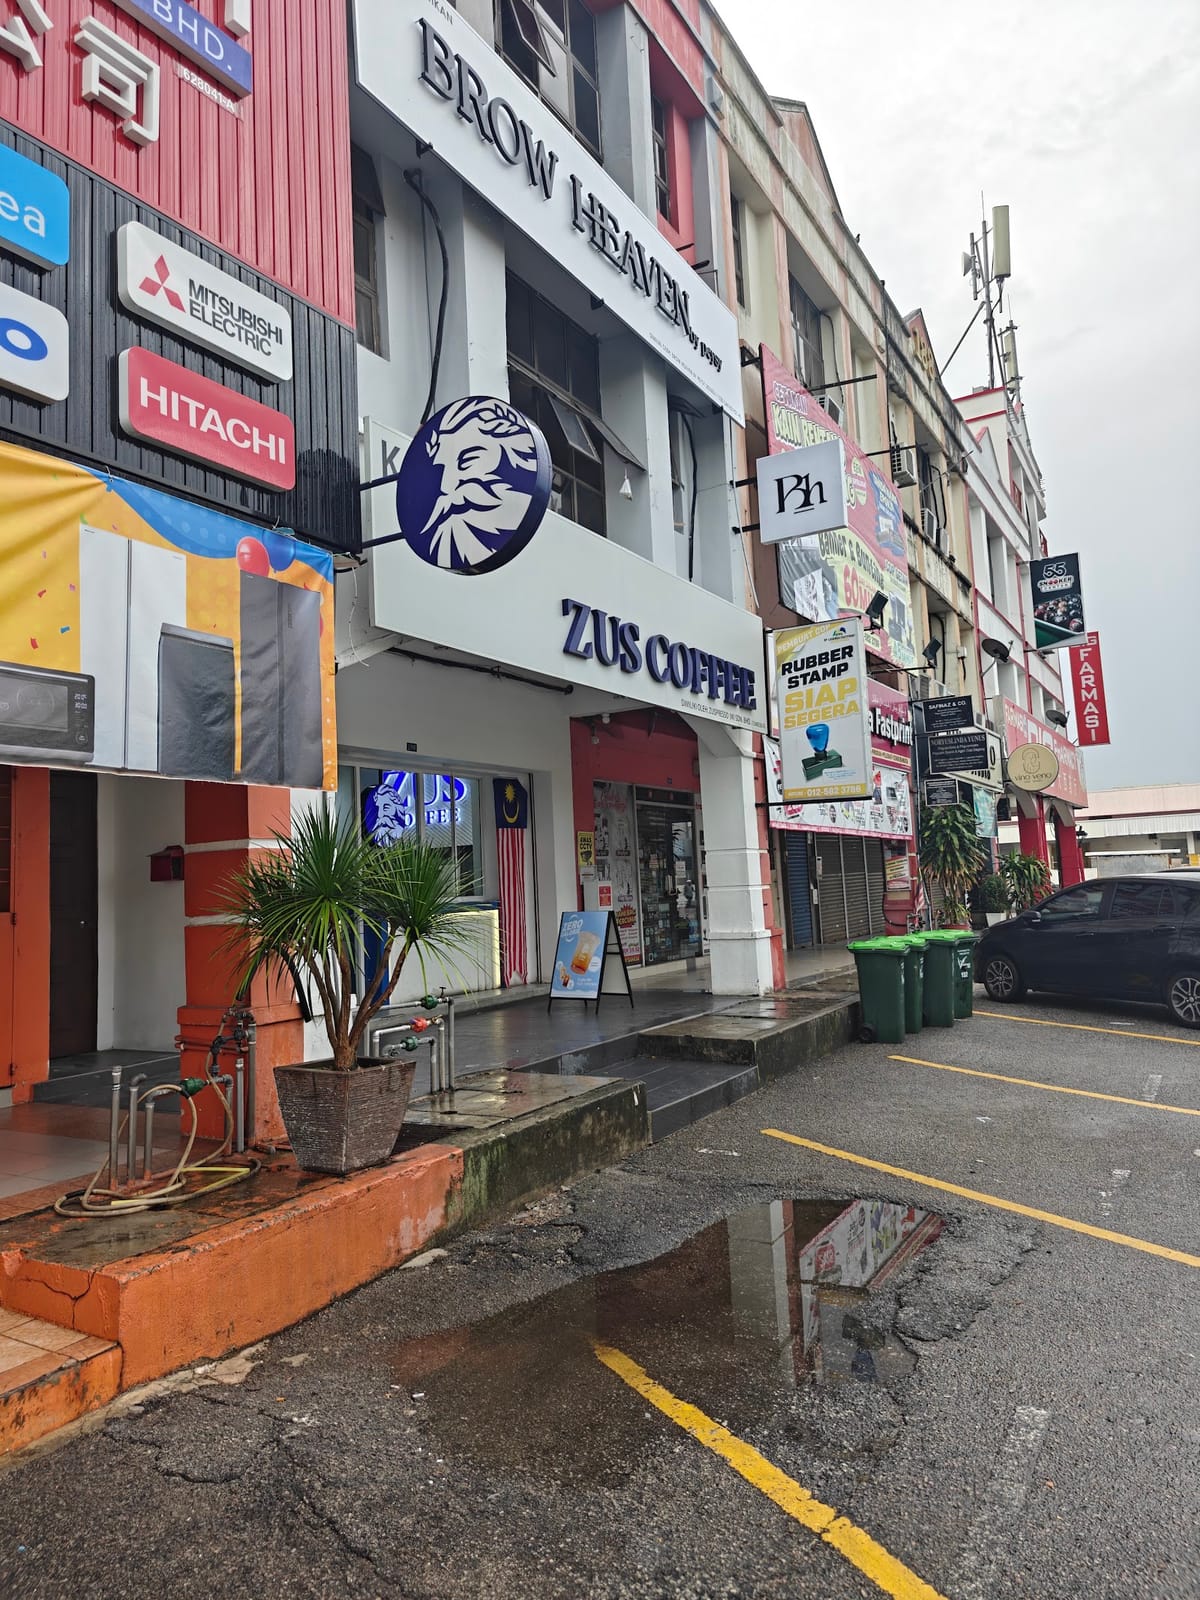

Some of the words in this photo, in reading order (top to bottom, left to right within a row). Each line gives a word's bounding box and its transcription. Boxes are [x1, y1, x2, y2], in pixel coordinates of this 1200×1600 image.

[416, 18, 558, 201] BROW
[569, 173, 692, 337] HEAVEN
[189, 278, 283, 345] MITSUBISHI
[189, 302, 272, 357] ELECTRIC
[140, 376, 286, 465] HITACHI
[562, 597, 642, 674] ZUS
[646, 634, 757, 711] COFFEE
[781, 645, 854, 676] RUBBER
[787, 662, 849, 690] STAMP
[783, 700, 860, 730] SEGERA
[784, 677, 858, 715] SIAP
[1079, 648, 1099, 743] FARMASI
[579, 842, 593, 850] CCTV
